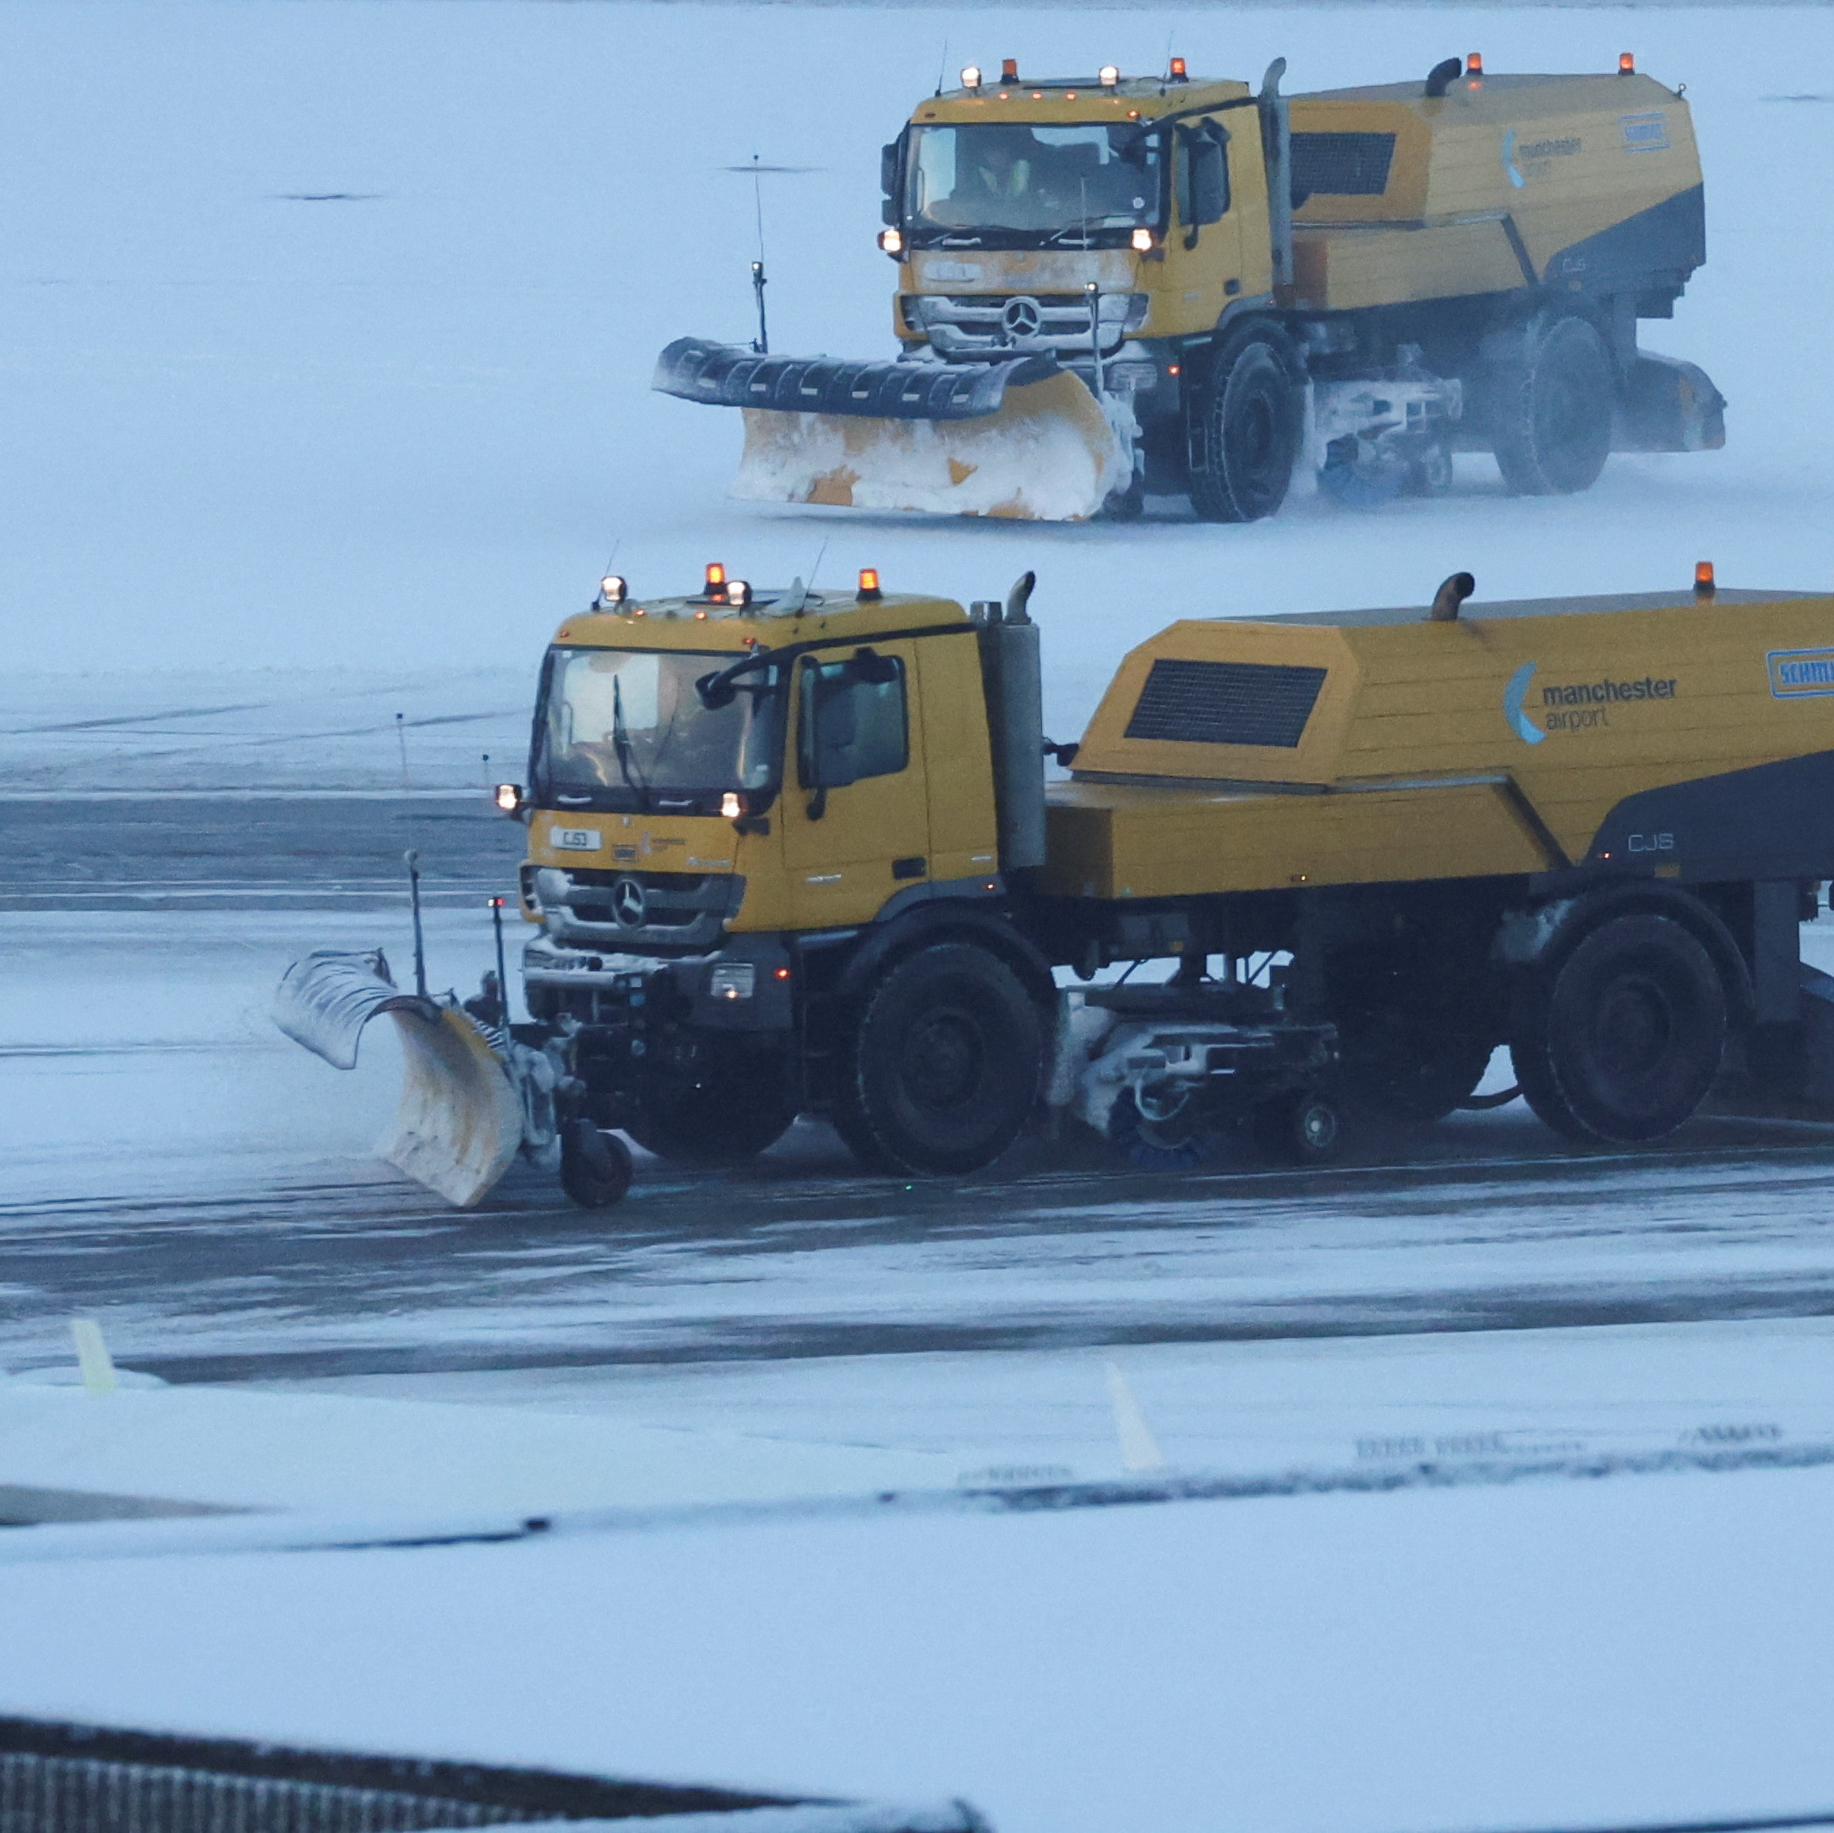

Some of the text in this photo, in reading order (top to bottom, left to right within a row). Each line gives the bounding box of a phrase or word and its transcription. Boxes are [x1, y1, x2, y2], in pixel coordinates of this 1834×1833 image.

[1543, 676, 1678, 707] manchester
[1545, 707, 1609, 733] airport
[1627, 832, 1675, 853] CJS
